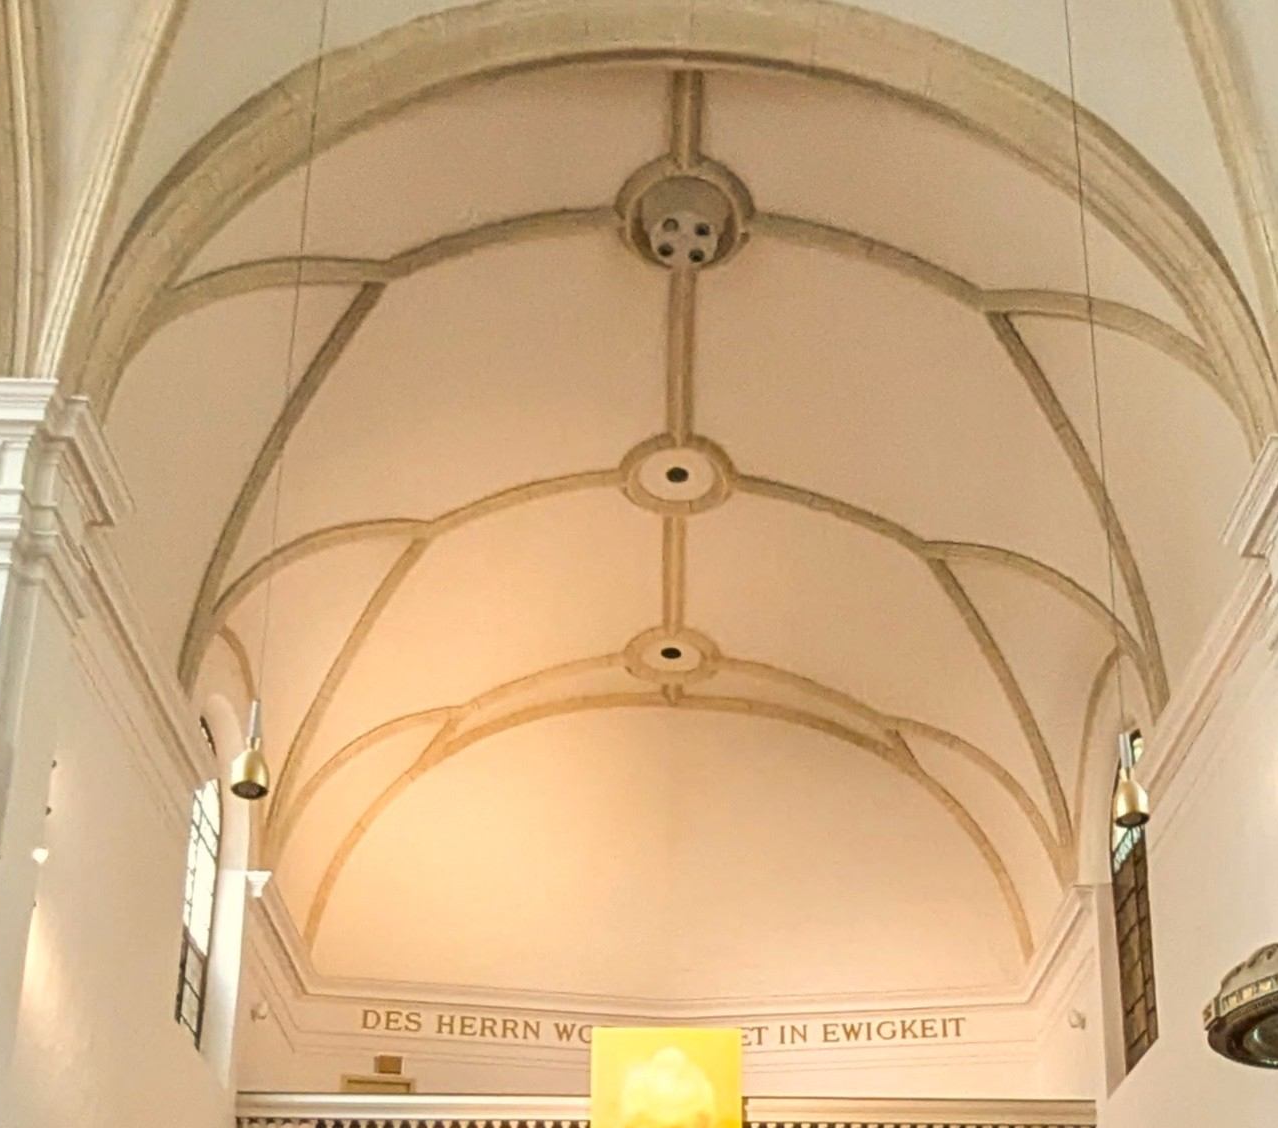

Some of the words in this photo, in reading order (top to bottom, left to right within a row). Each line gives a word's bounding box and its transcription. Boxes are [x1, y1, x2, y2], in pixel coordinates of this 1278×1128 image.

[361, 1009, 422, 1032] DES
[435, 1014, 541, 1040] HERRN
[553, 1021, 592, 1044] WO
[779, 1024, 808, 1045] IN
[822, 1017, 966, 1043] EWIGKEIT
